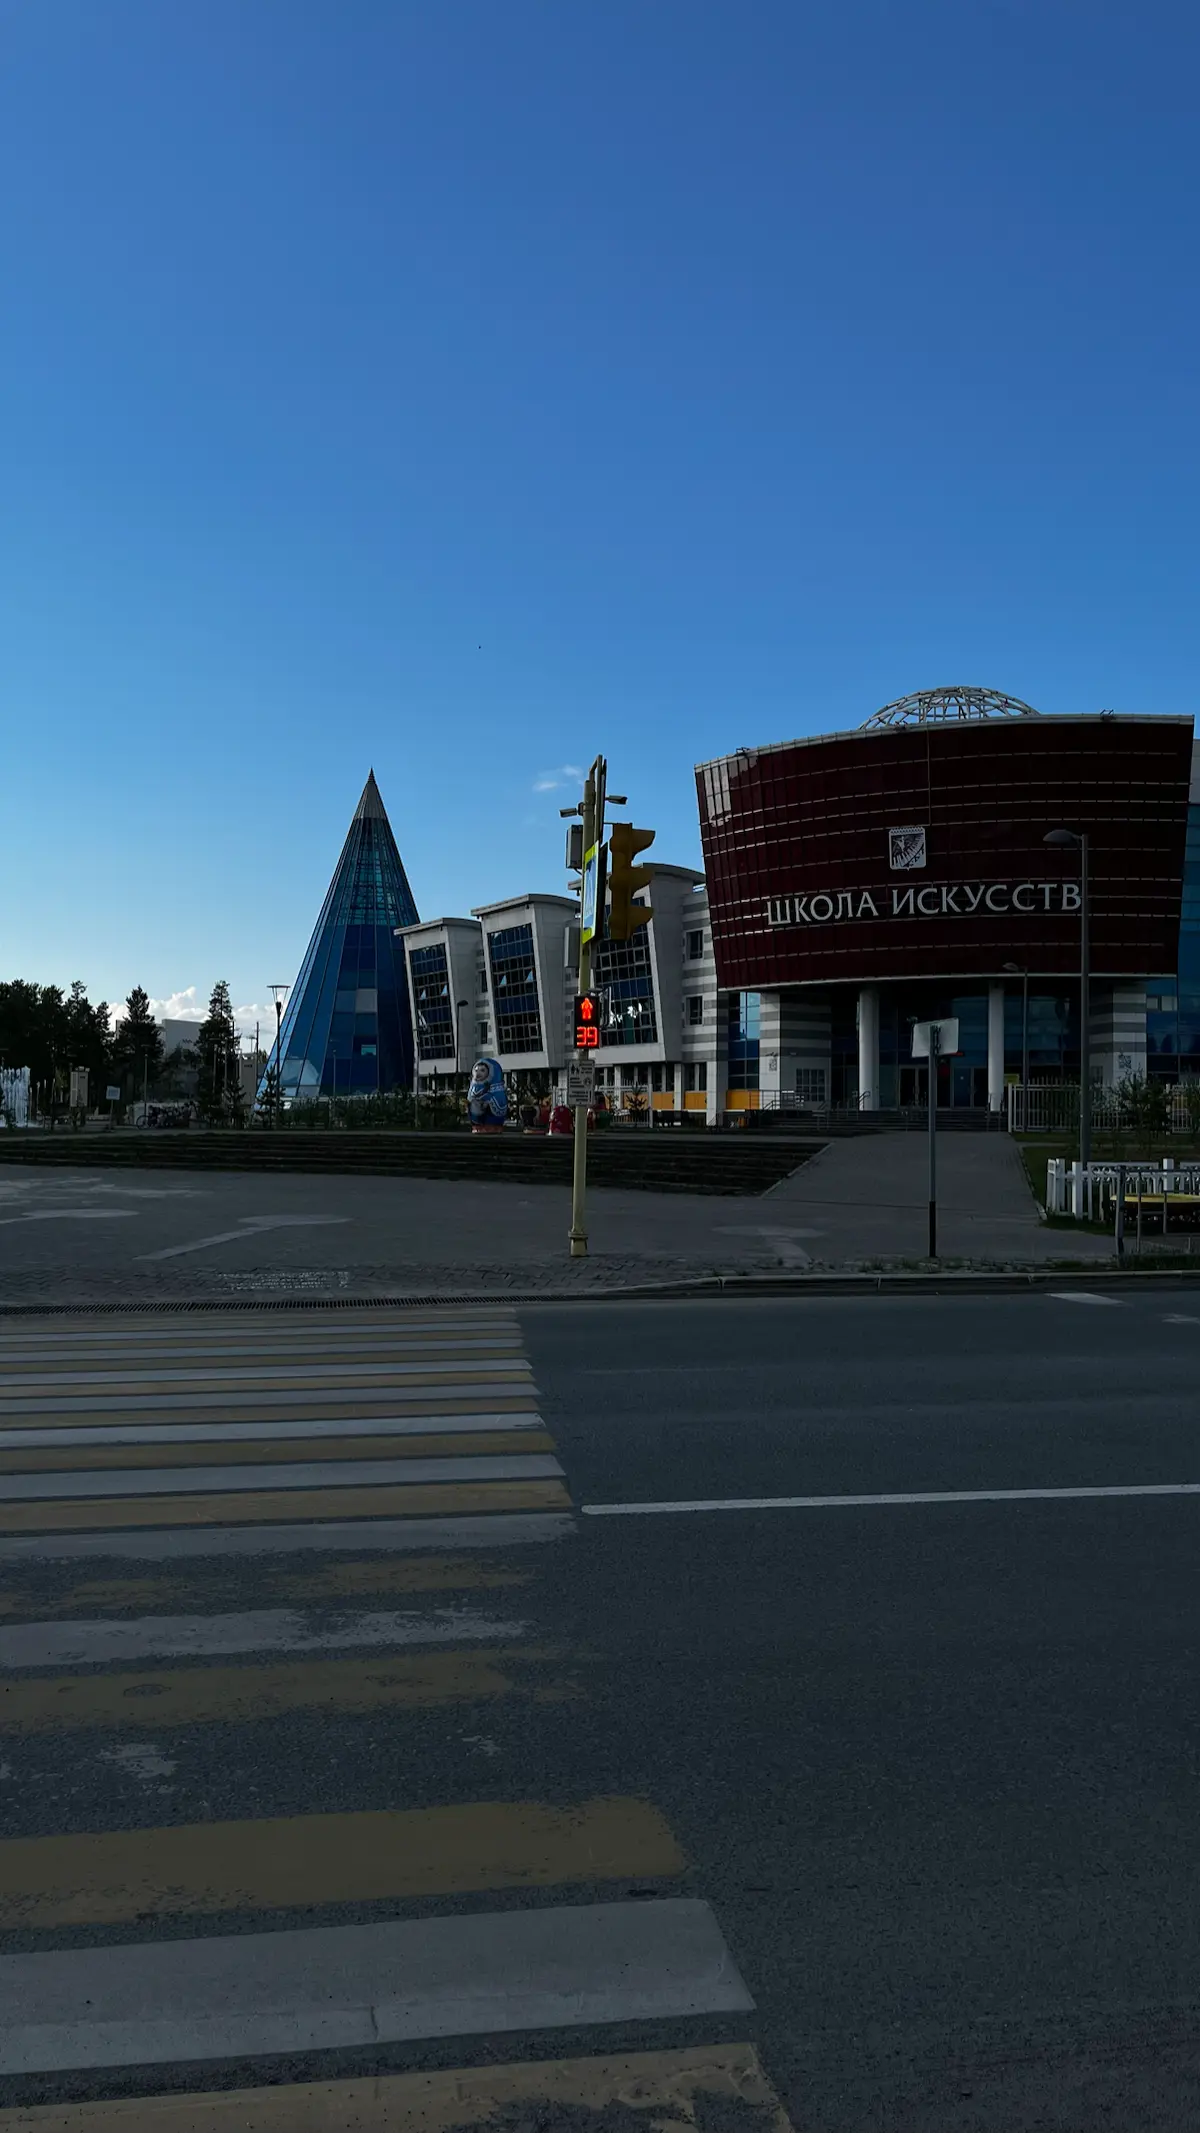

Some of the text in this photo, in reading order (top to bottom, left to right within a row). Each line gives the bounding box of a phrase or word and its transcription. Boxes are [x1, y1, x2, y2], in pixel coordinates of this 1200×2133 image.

[766, 883, 1082, 926] ШКОЛА ИСКУССТВ
[576, 1026, 598, 1047] 39
